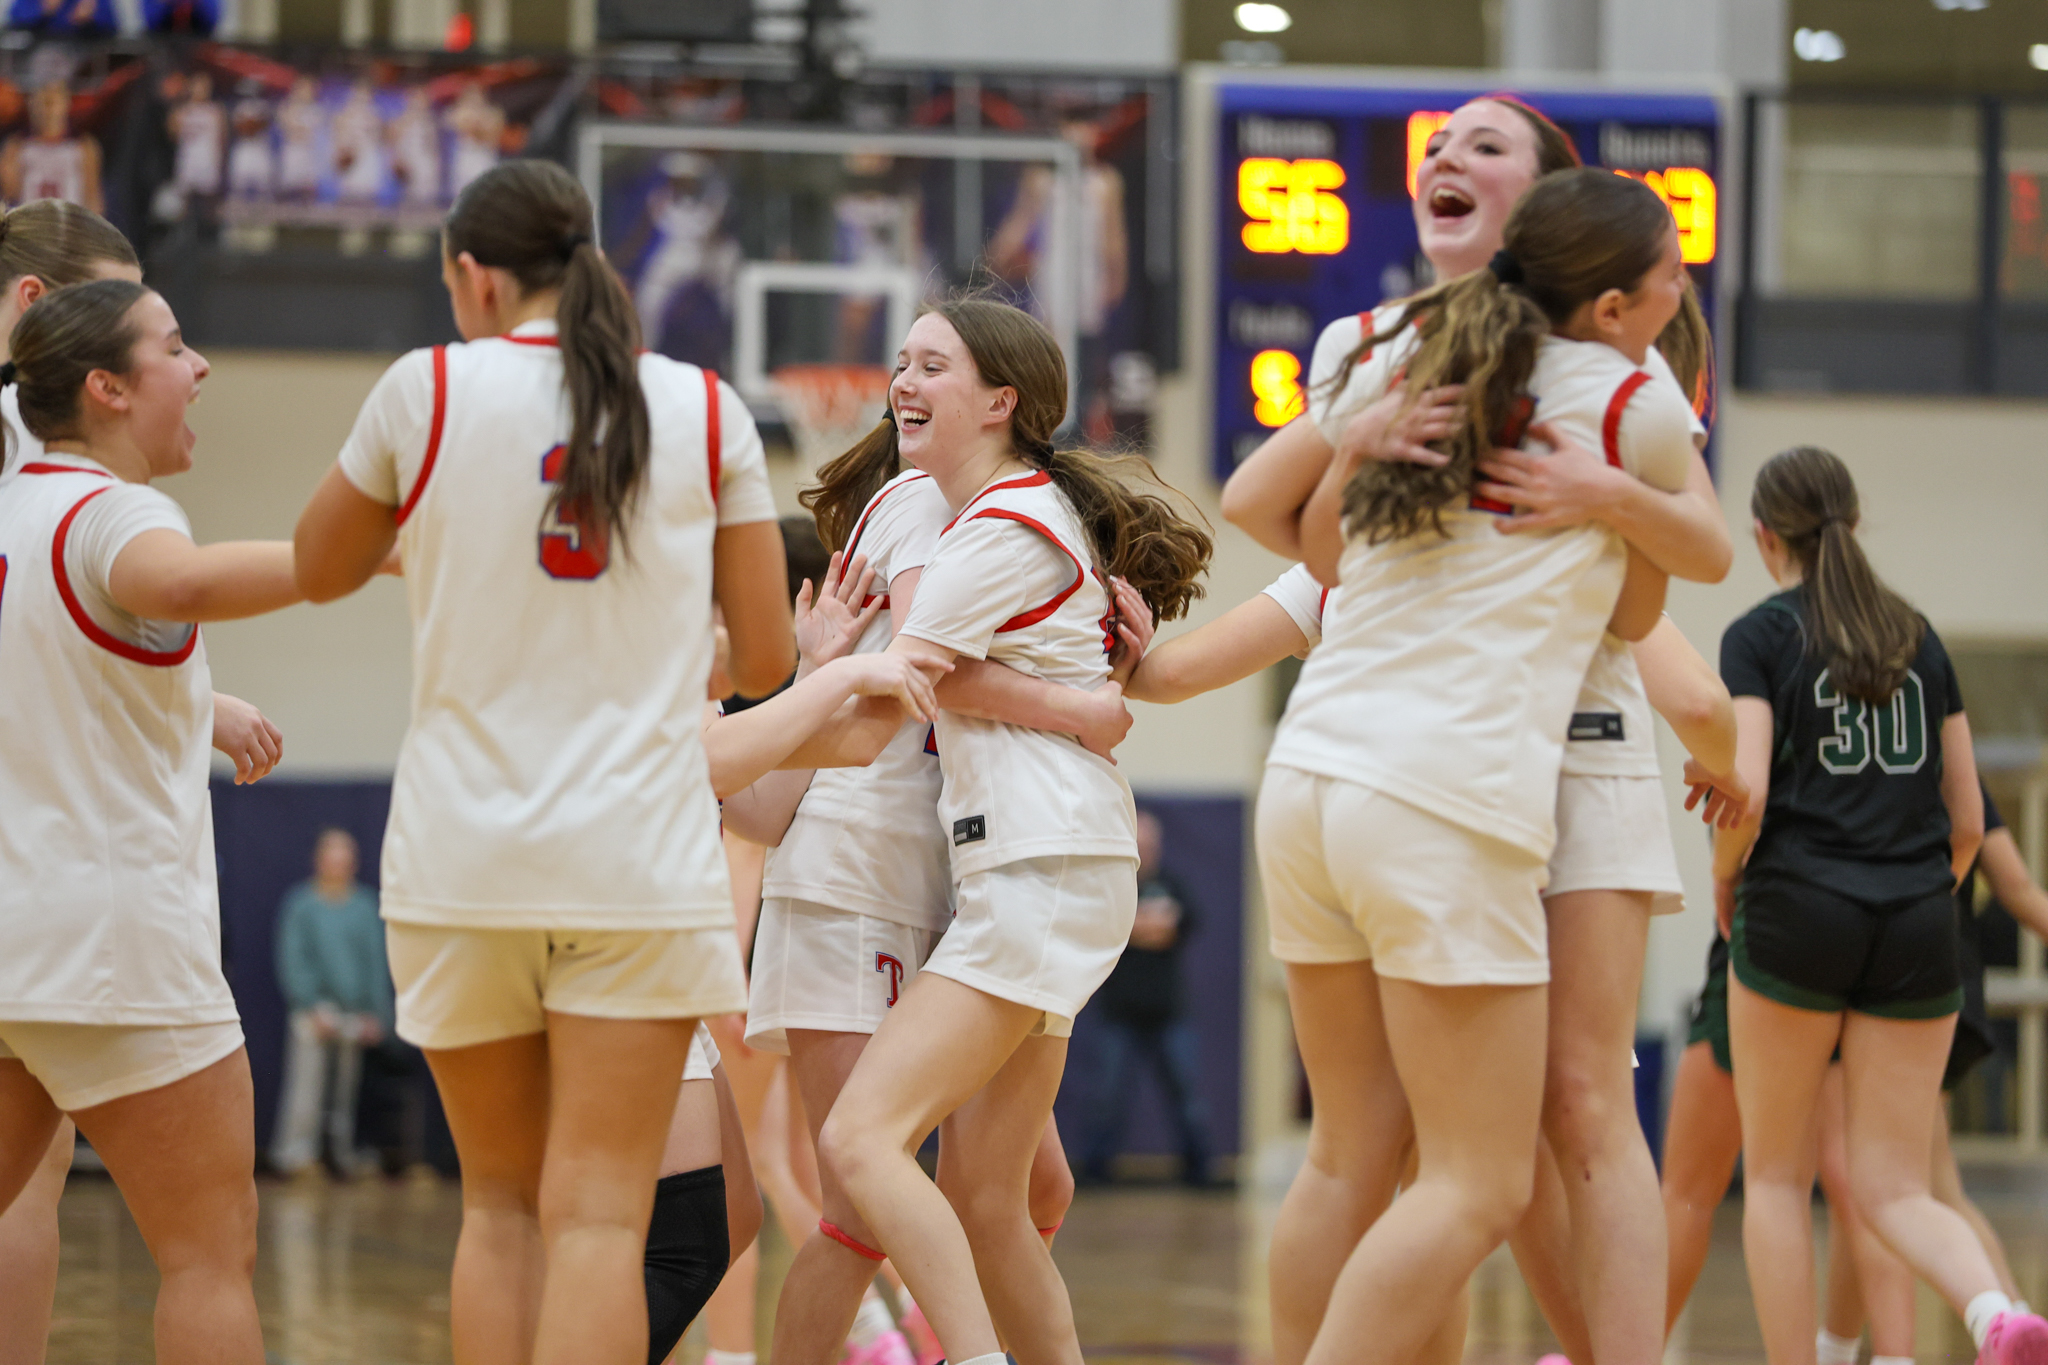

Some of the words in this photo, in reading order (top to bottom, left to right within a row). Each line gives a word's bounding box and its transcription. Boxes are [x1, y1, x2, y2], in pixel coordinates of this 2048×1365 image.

[1239, 158, 1349, 254] 56
[1814, 667, 1927, 775] 30
[971, 823, 979, 834] M
[875, 951, 904, 1008] T
